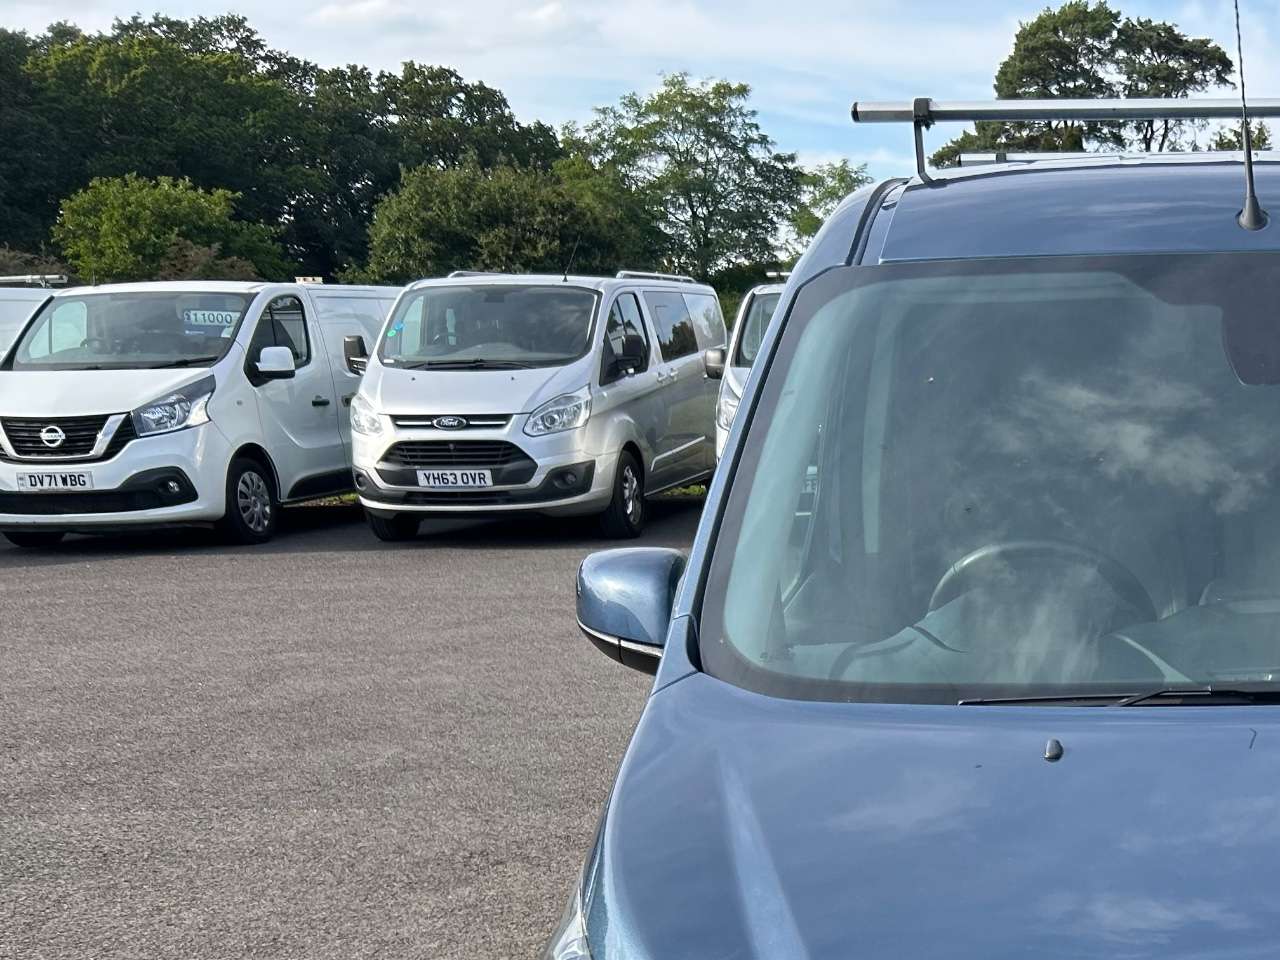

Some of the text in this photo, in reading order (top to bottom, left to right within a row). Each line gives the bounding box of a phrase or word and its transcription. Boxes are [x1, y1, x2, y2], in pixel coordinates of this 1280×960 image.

[28, 475, 58, 487] DV71
[60, 474, 87, 486] WBG
[423, 472, 487, 485] YH63 OVR
